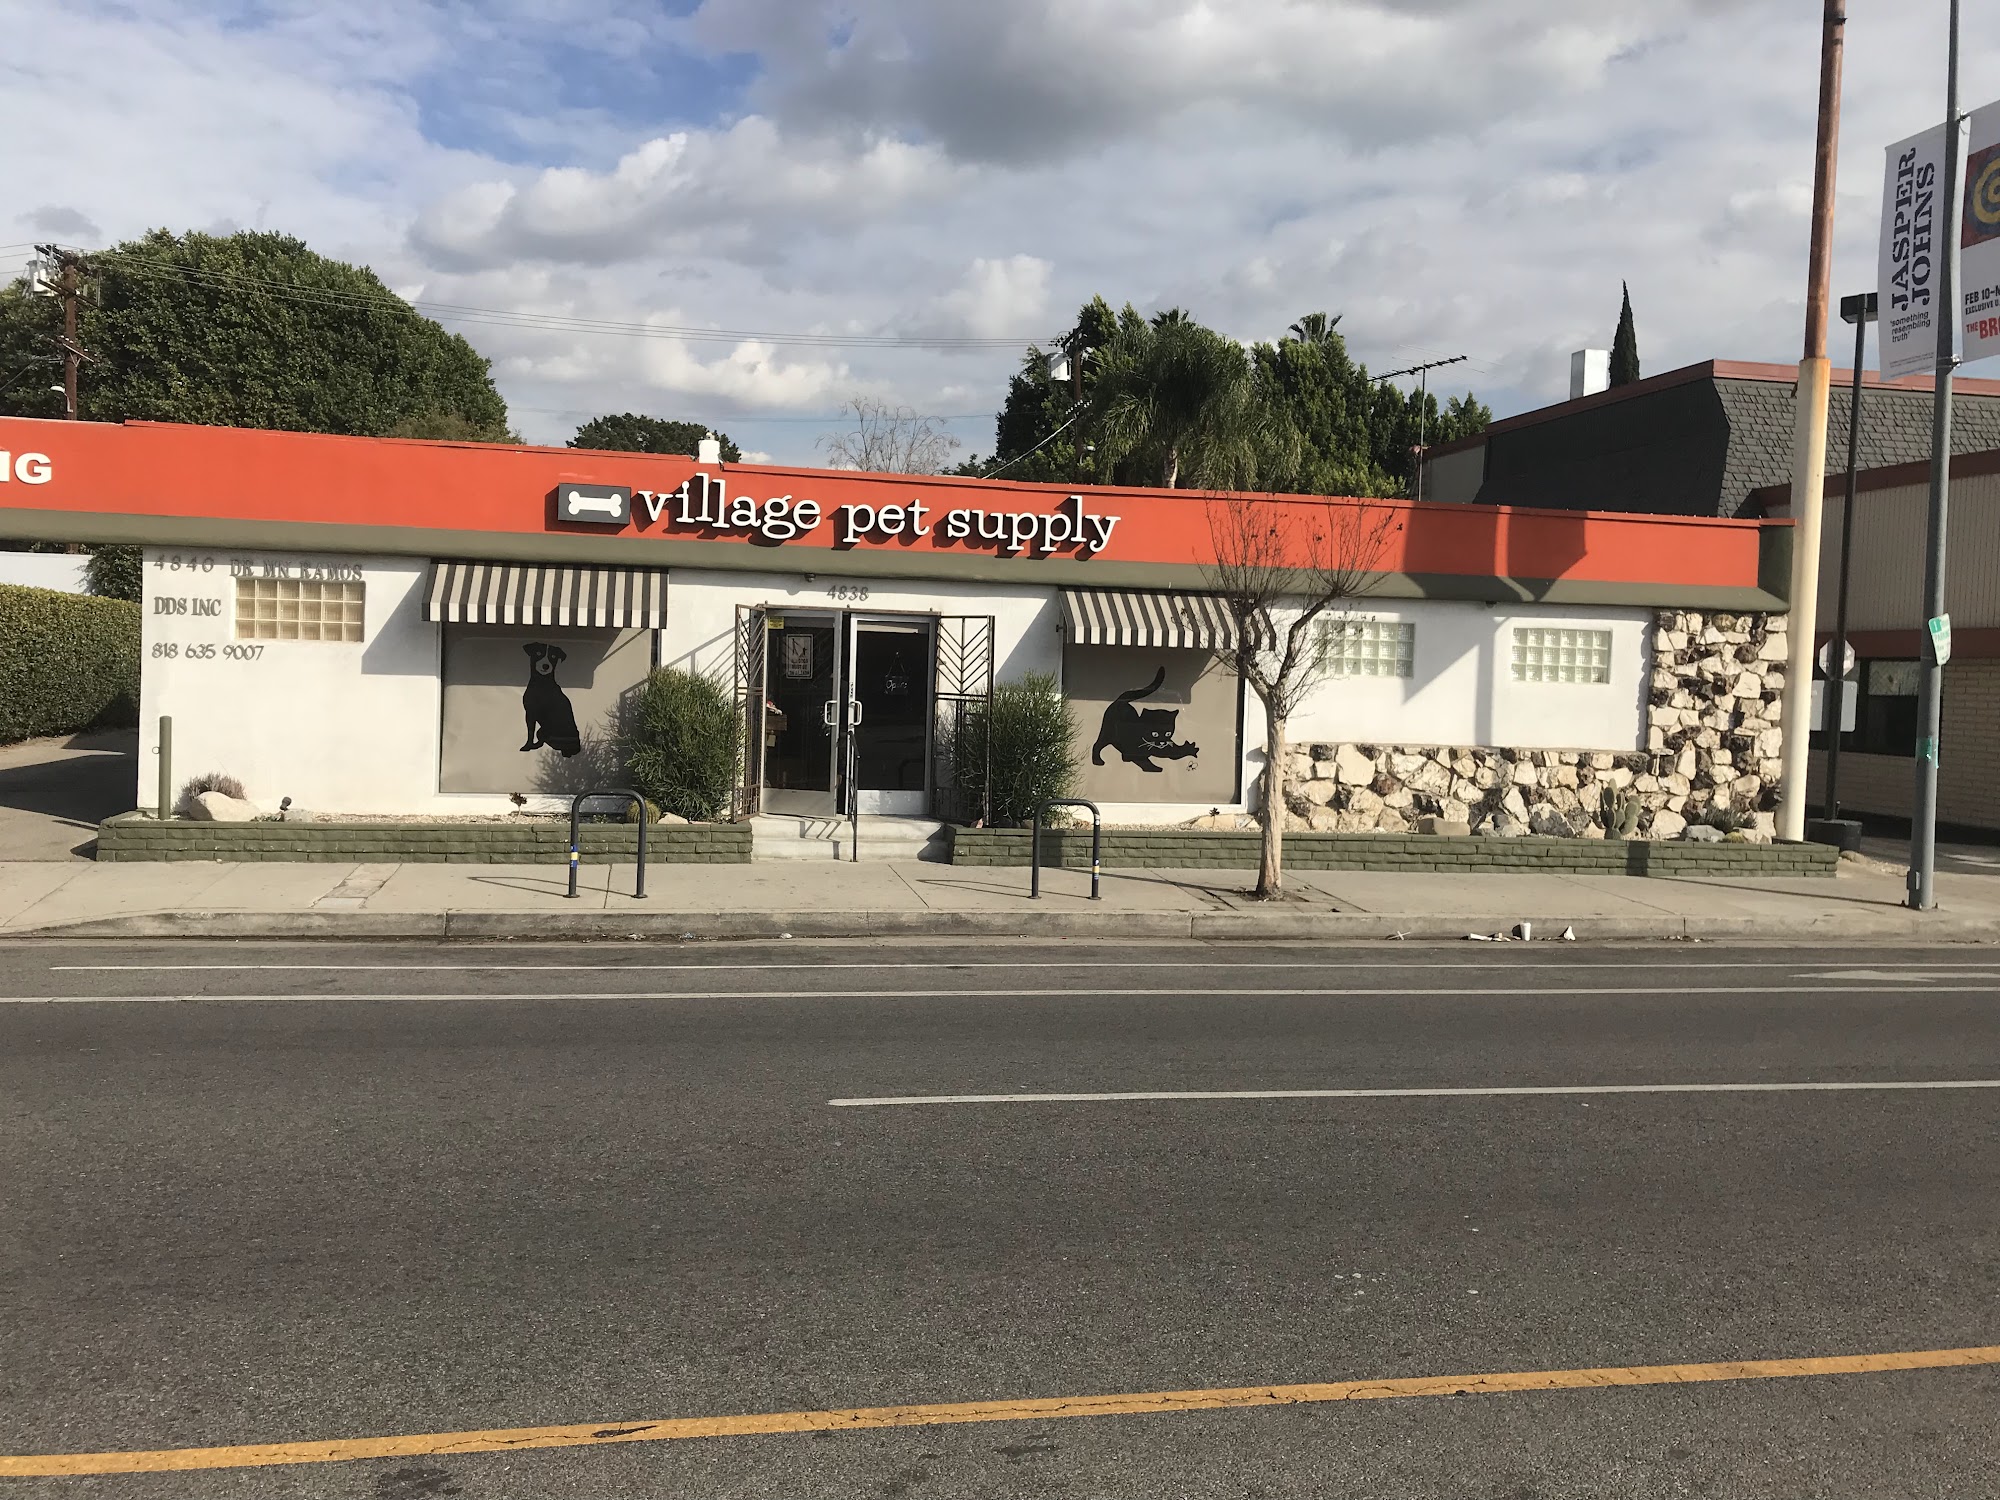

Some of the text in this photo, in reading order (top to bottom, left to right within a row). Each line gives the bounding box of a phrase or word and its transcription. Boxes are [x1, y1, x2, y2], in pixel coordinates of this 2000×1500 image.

[1891, 147, 1916, 311] JASPER
[1911, 162, 1935, 306] JOHNS
[1965, 291, 1979, 305] FEB
[1965, 300, 1993, 315] EXCLUSIVE
[1892, 319, 1931, 335] resembling
[1966, 316, 2000, 339] THE BR
[638, 473, 1121, 553] village pet supply
[154, 554, 215, 573] 4840
[230, 559, 254, 578] DR
[299, 560, 363, 582] RAMOS
[826, 585, 870, 602] 4838
[154, 597, 221, 617] DDS INC
[151, 642, 265, 661] 818 635 9007
